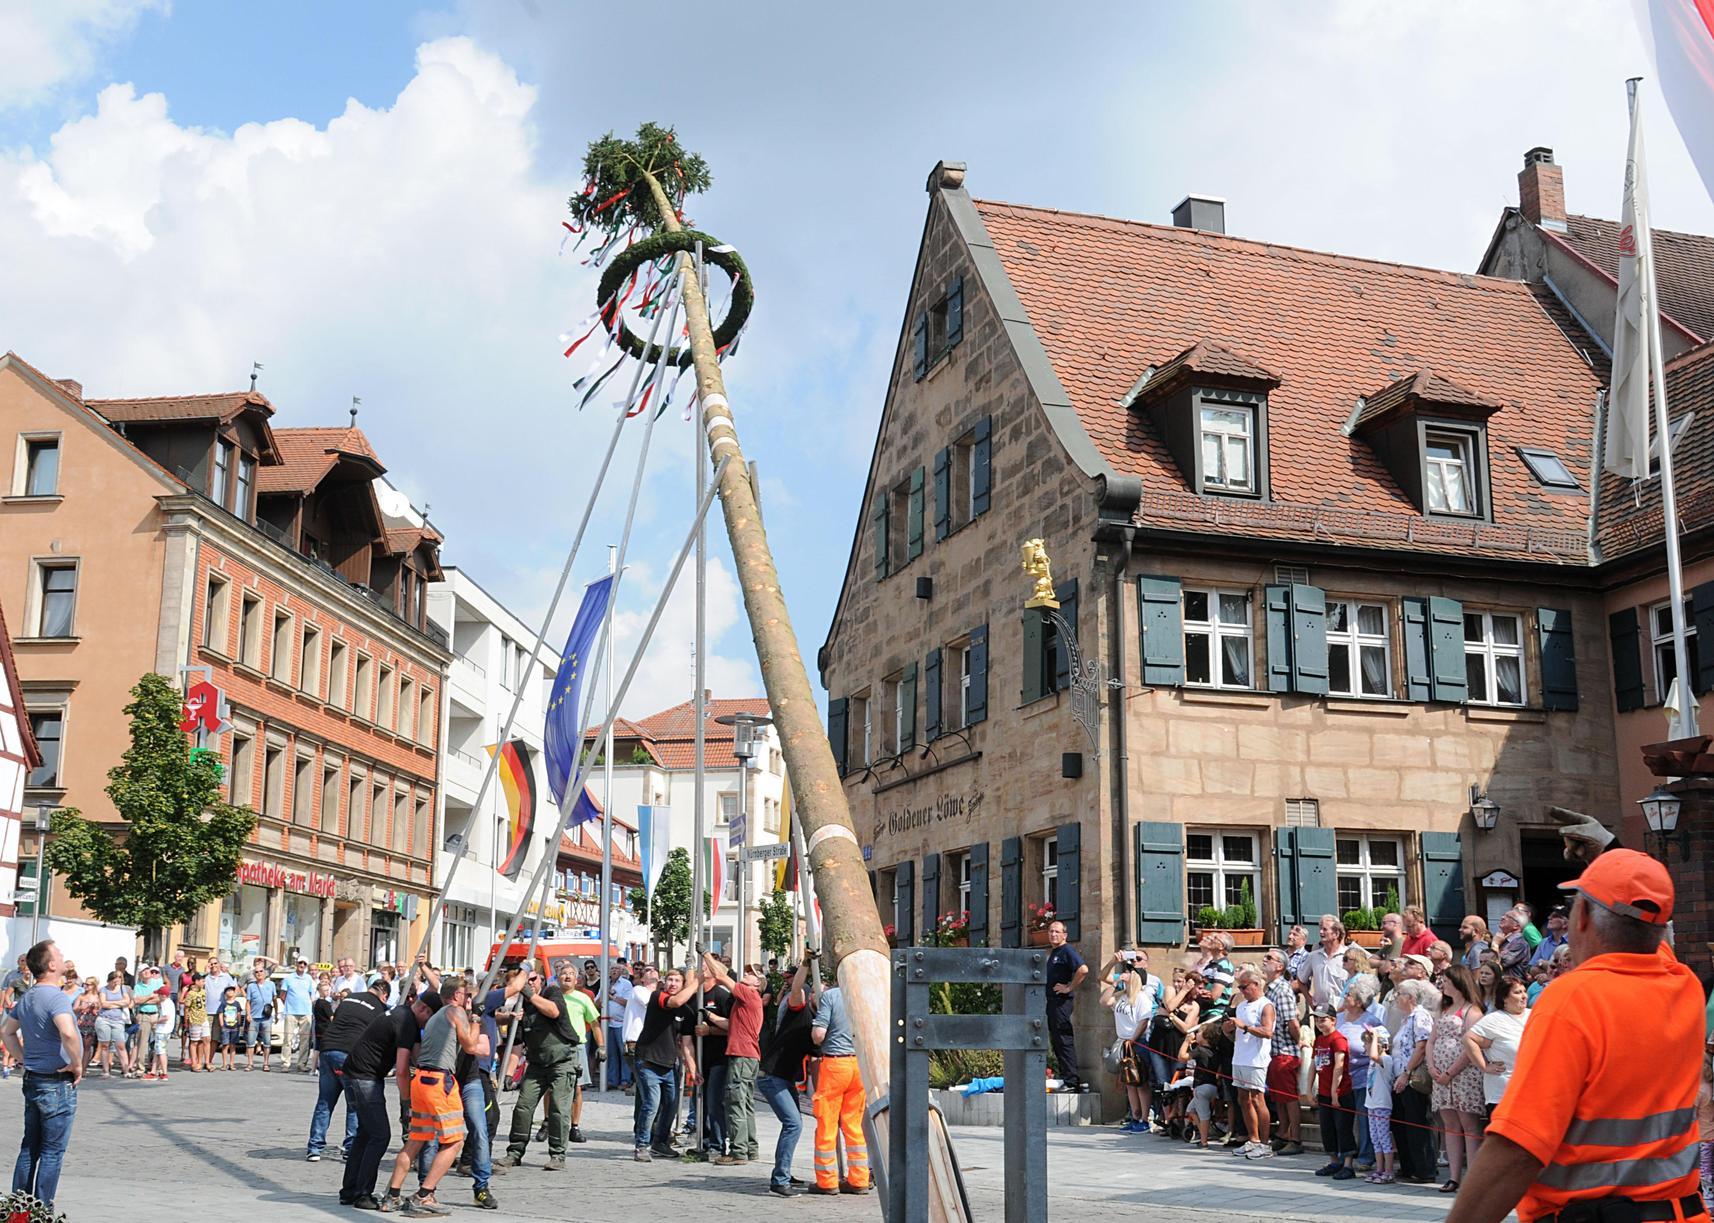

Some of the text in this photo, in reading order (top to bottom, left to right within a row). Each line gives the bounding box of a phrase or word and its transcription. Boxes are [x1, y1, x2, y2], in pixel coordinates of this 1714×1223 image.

[888, 794, 964, 836] Goldener Löwe
[289, 872, 306, 892] am
[308, 870, 336, 897] Markt
